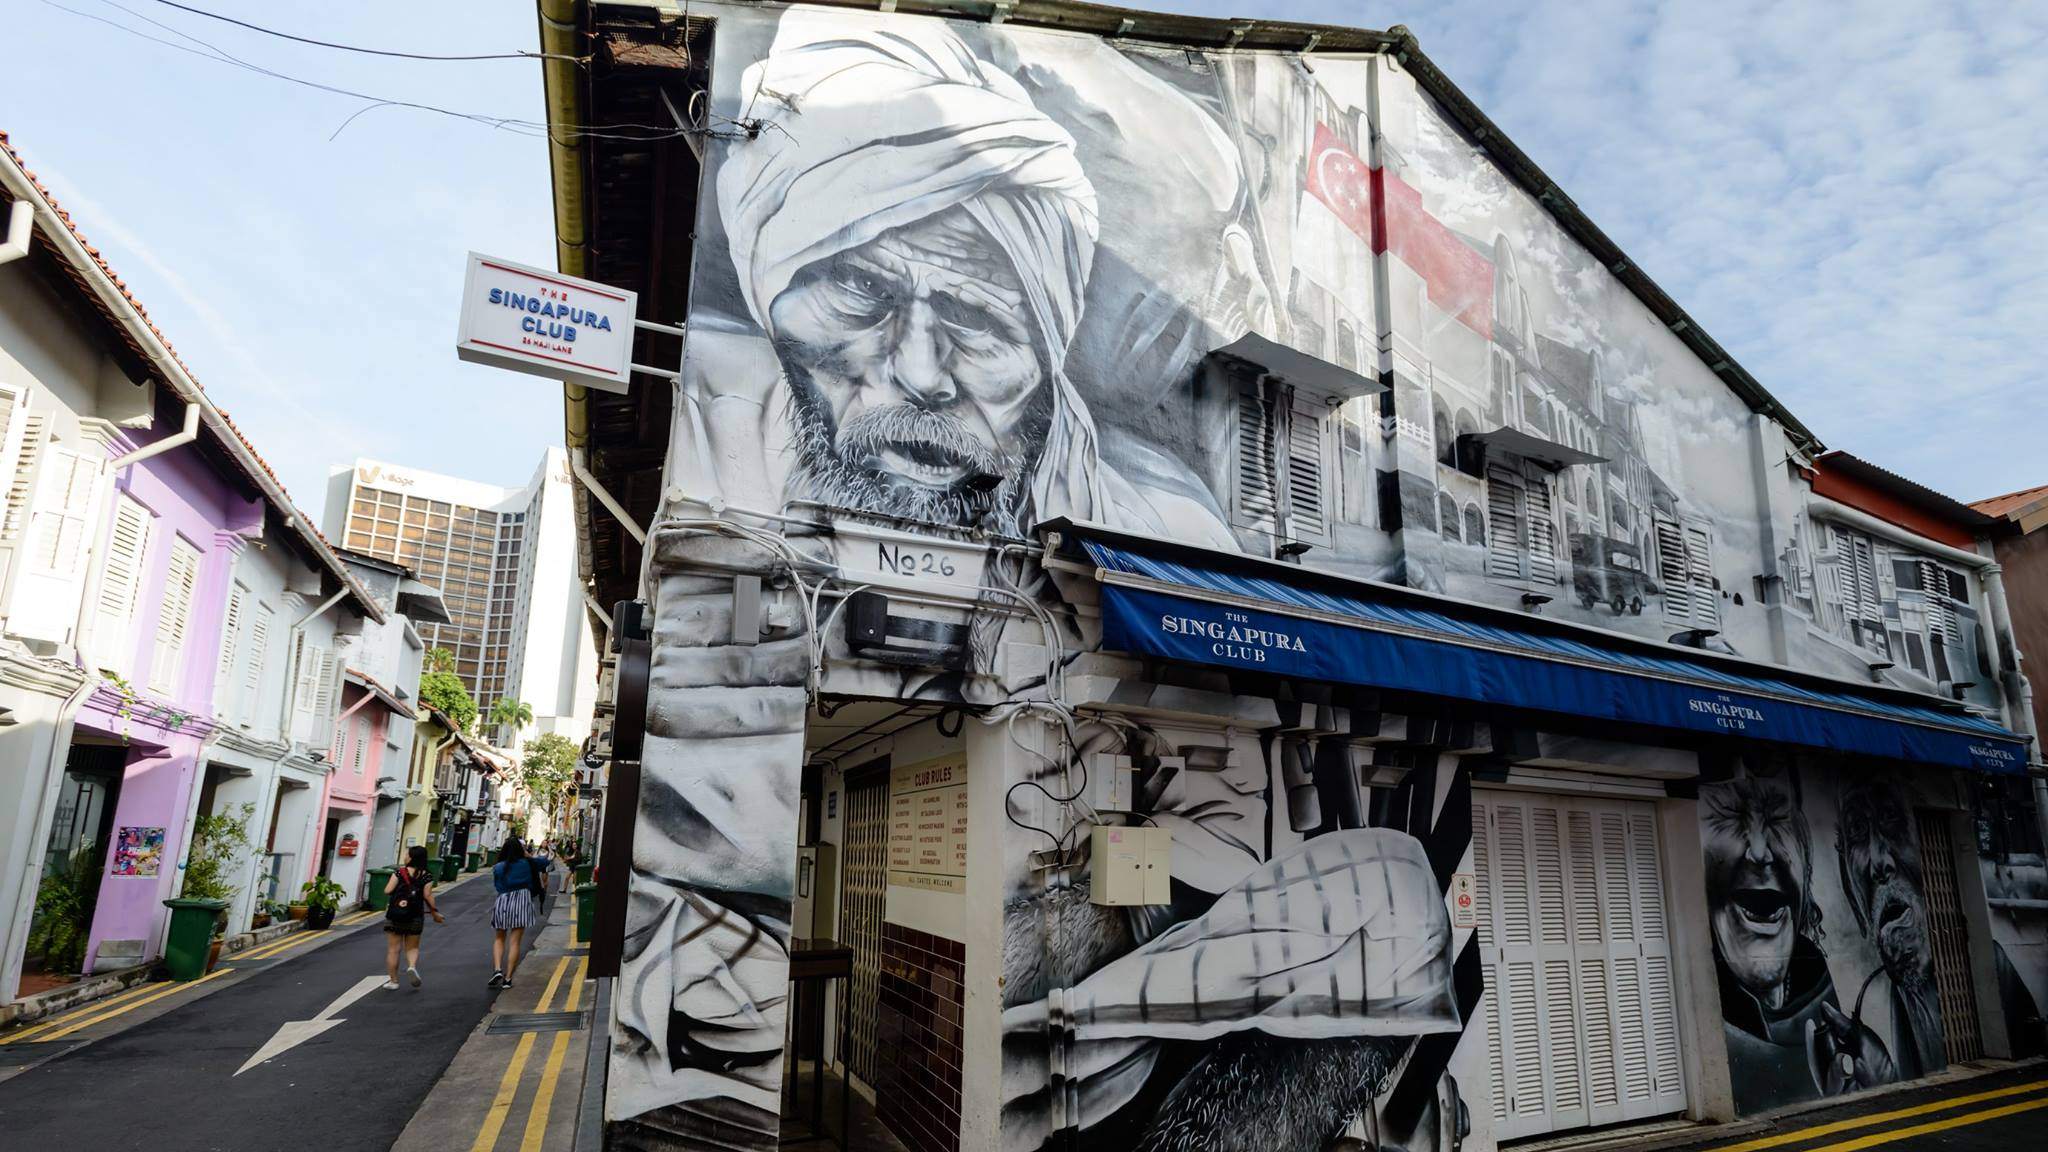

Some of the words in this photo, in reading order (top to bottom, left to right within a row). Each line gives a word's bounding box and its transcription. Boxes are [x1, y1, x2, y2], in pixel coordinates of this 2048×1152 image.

[541, 287, 568, 301] THE
[488, 288, 612, 332] SINGAPURA
[521, 316, 577, 342] CLUB
[533, 340, 551, 350] HAJI
[552, 344, 572, 354] LANE
[921, 552, 955, 576] 26
[1225, 612, 1249, 624] THE
[1162, 614, 1307, 653] SINGAPURA
[1213, 643, 1266, 662] CLUB
[1689, 698, 1764, 721] SINGAPURA
[1716, 717, 1745, 729] CLUB
[915, 771, 930, 786] CLUB
[931, 766, 952, 783] RULES
